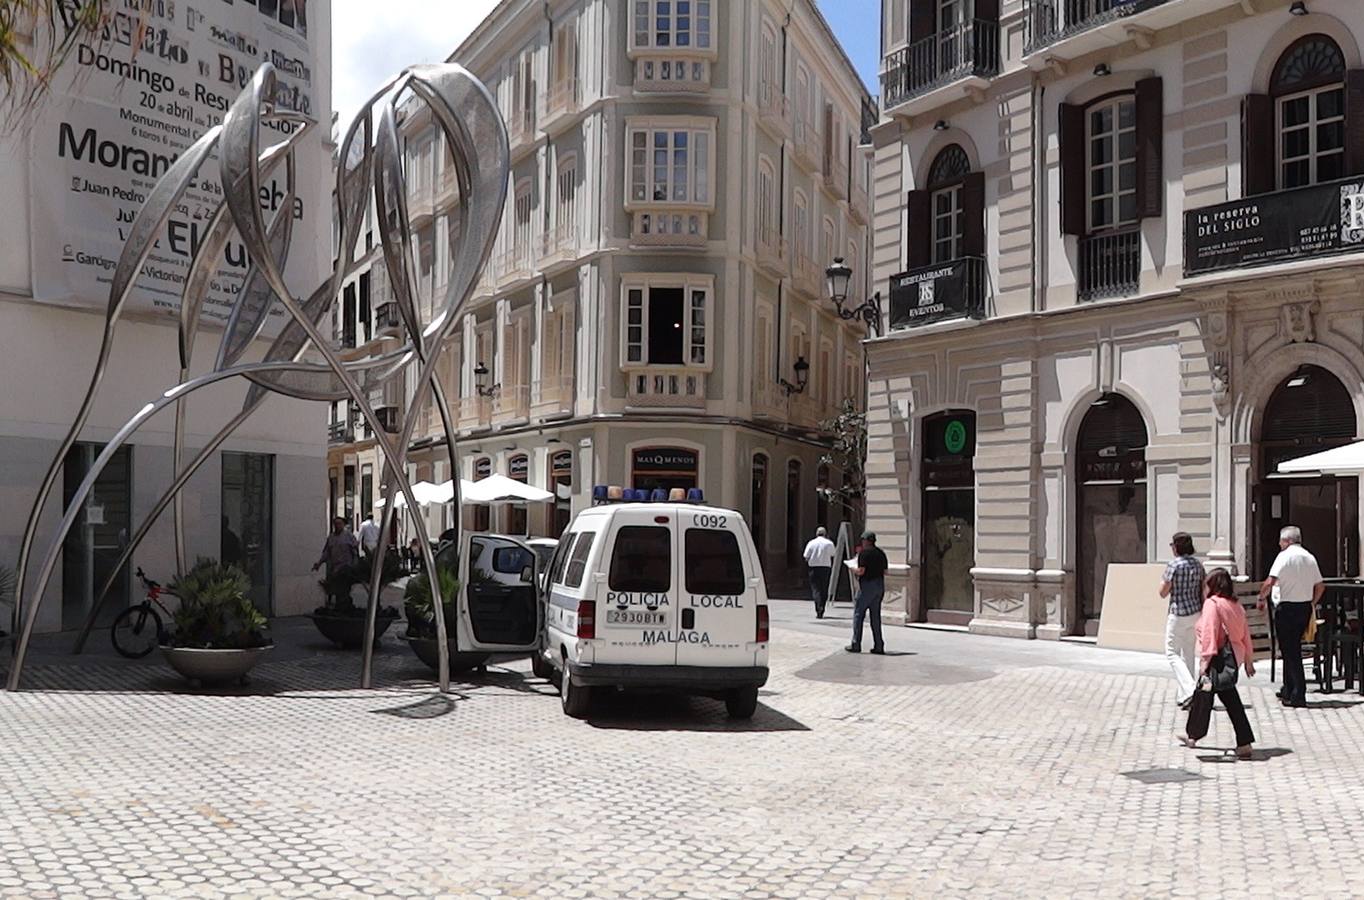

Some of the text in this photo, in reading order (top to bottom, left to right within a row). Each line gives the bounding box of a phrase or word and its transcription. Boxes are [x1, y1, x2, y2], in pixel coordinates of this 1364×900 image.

[78, 43, 175, 94] Domingo
[140, 91, 157, 109] 20
[166, 101, 193, 122] abril
[119, 108, 190, 137] Monumental
[82, 179, 110, 197] Juan
[112, 185, 145, 204] Pedro
[1198, 205, 1259, 225] la reserva
[1198, 215, 1261, 238] DEL SIGLO
[909, 303, 944, 316] EVENTOS
[700, 514, 727, 529] 092
[690, 595, 743, 608] LOCAL
